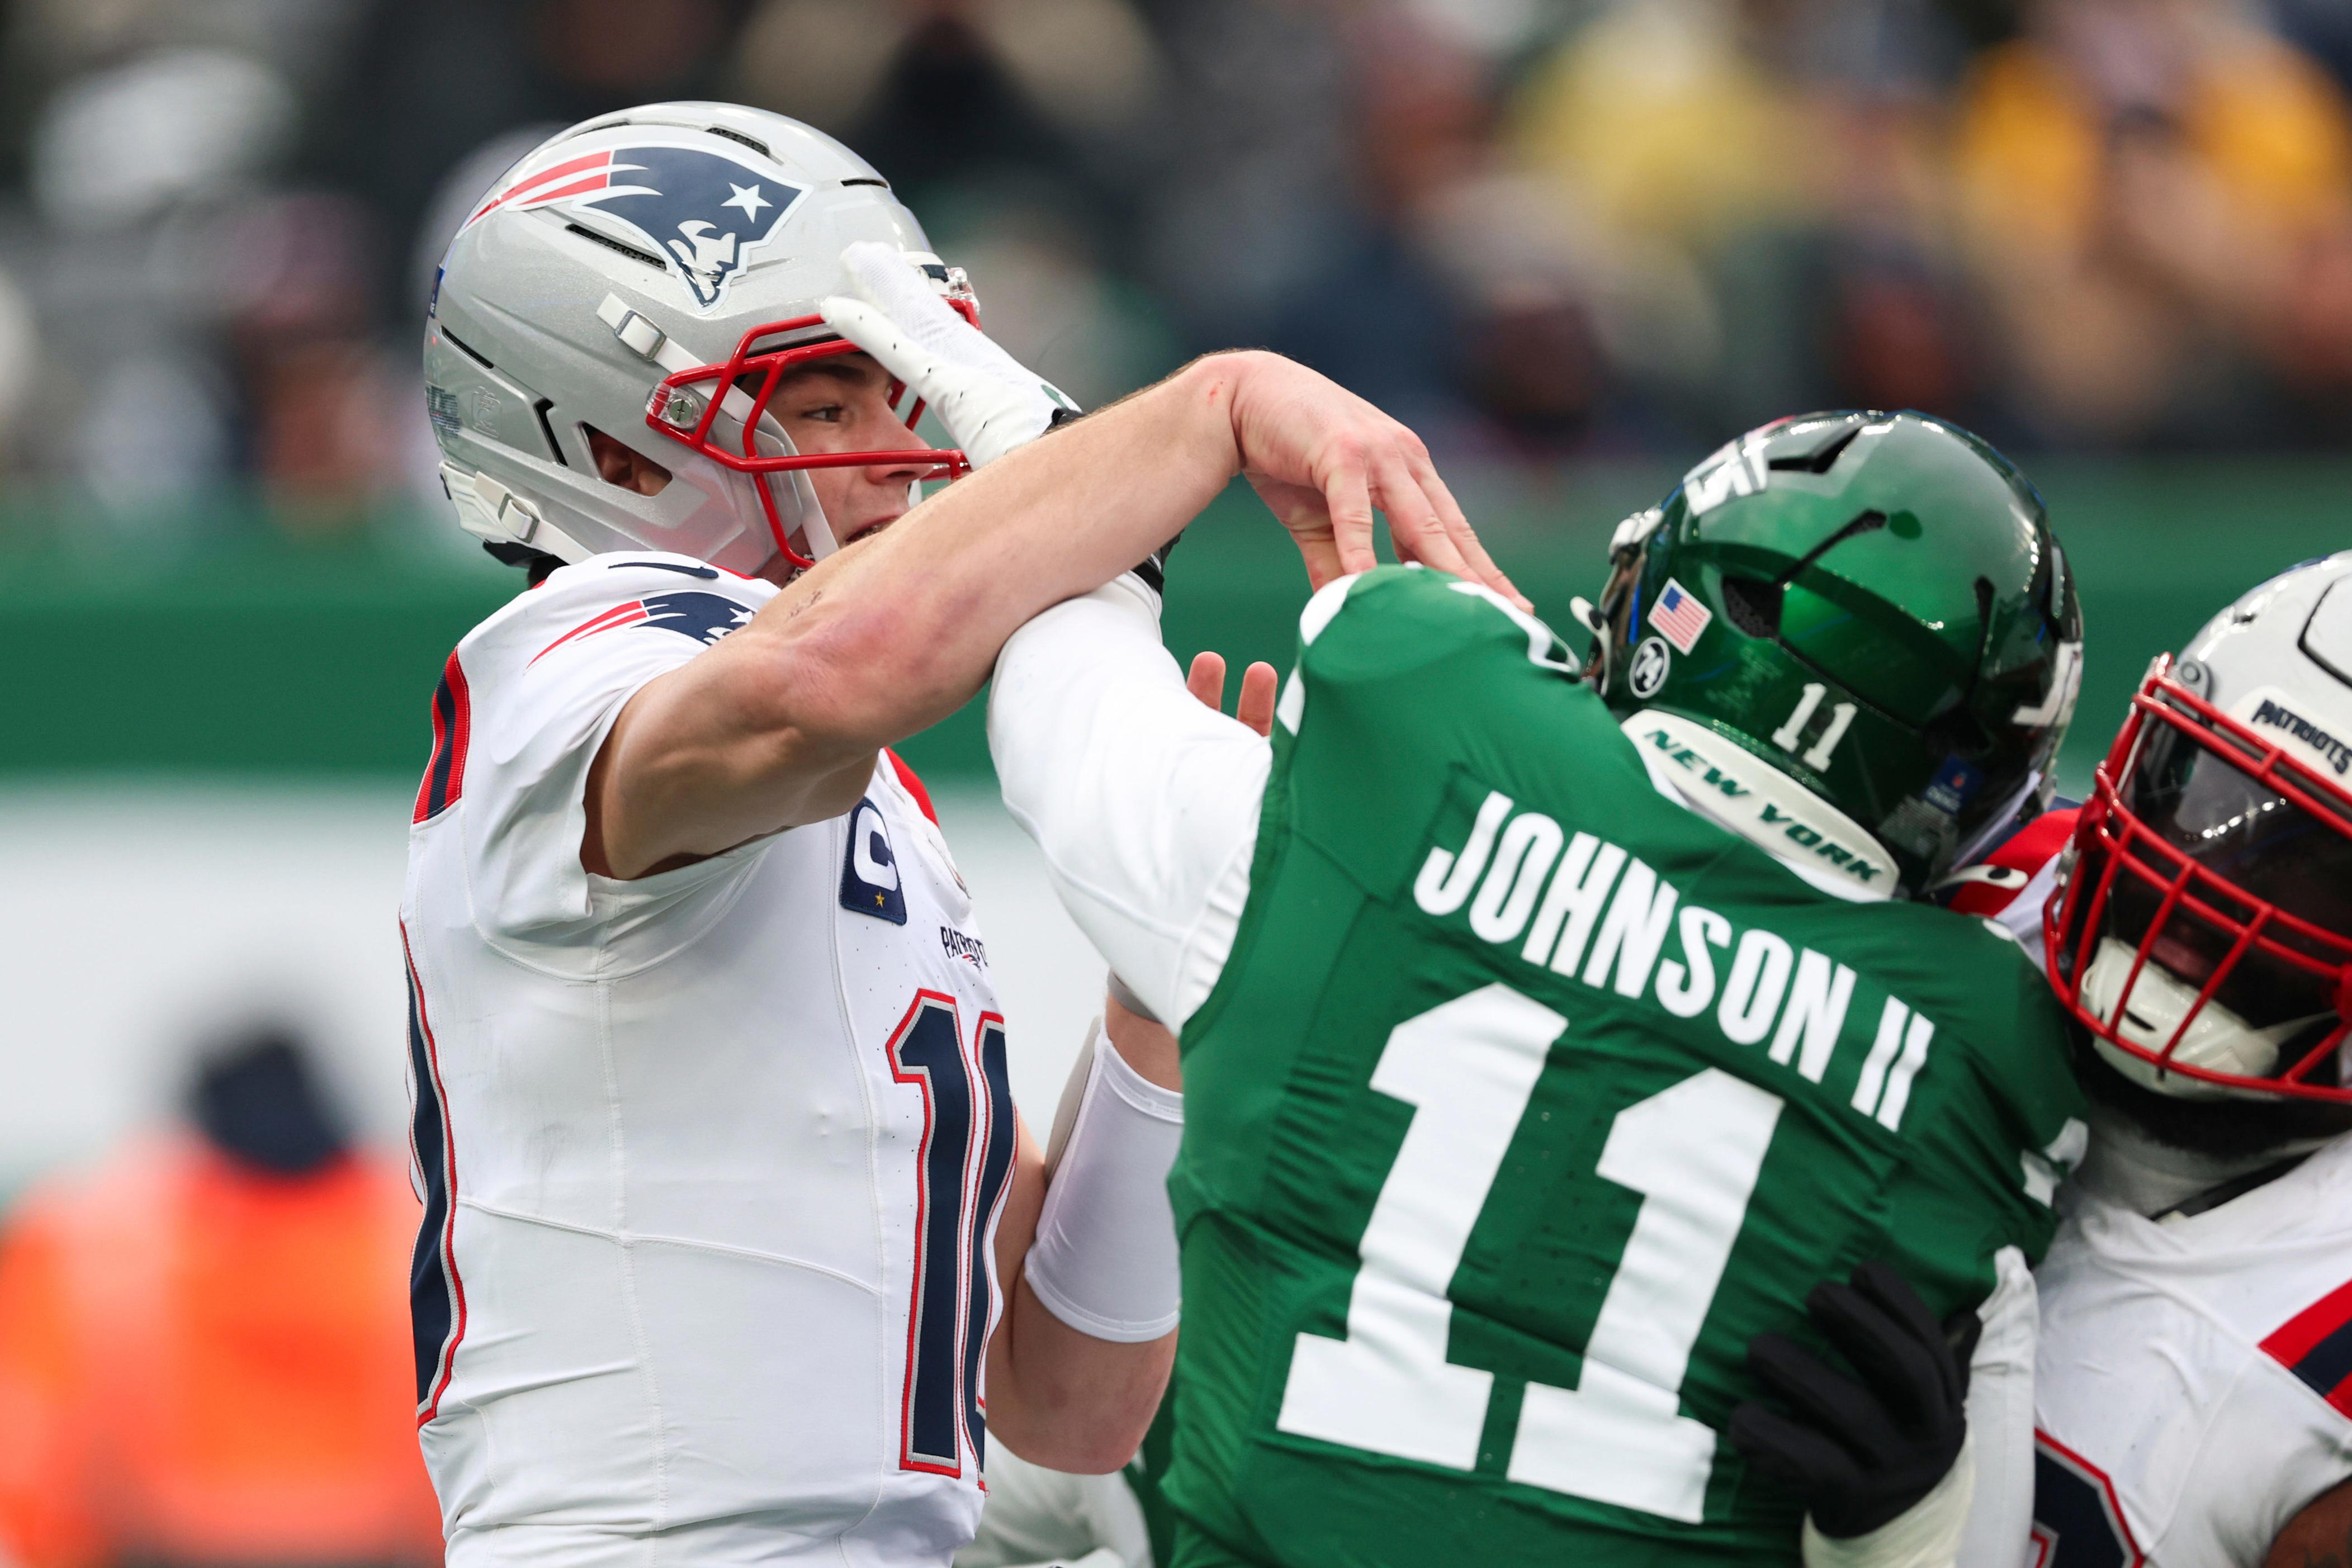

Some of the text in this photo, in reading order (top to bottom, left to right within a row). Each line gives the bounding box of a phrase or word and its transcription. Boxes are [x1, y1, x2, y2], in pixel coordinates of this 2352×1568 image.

[1771, 683, 1858, 773] 11
[2251, 699, 2352, 775] PATRIOTS
[853, 806, 898, 892] C
[1644, 729, 1752, 797] NEW
[1759, 803, 1882, 882] YORK
[1413, 789, 1858, 1084] JOHNSON
[1276, 981, 1785, 1524] 11
